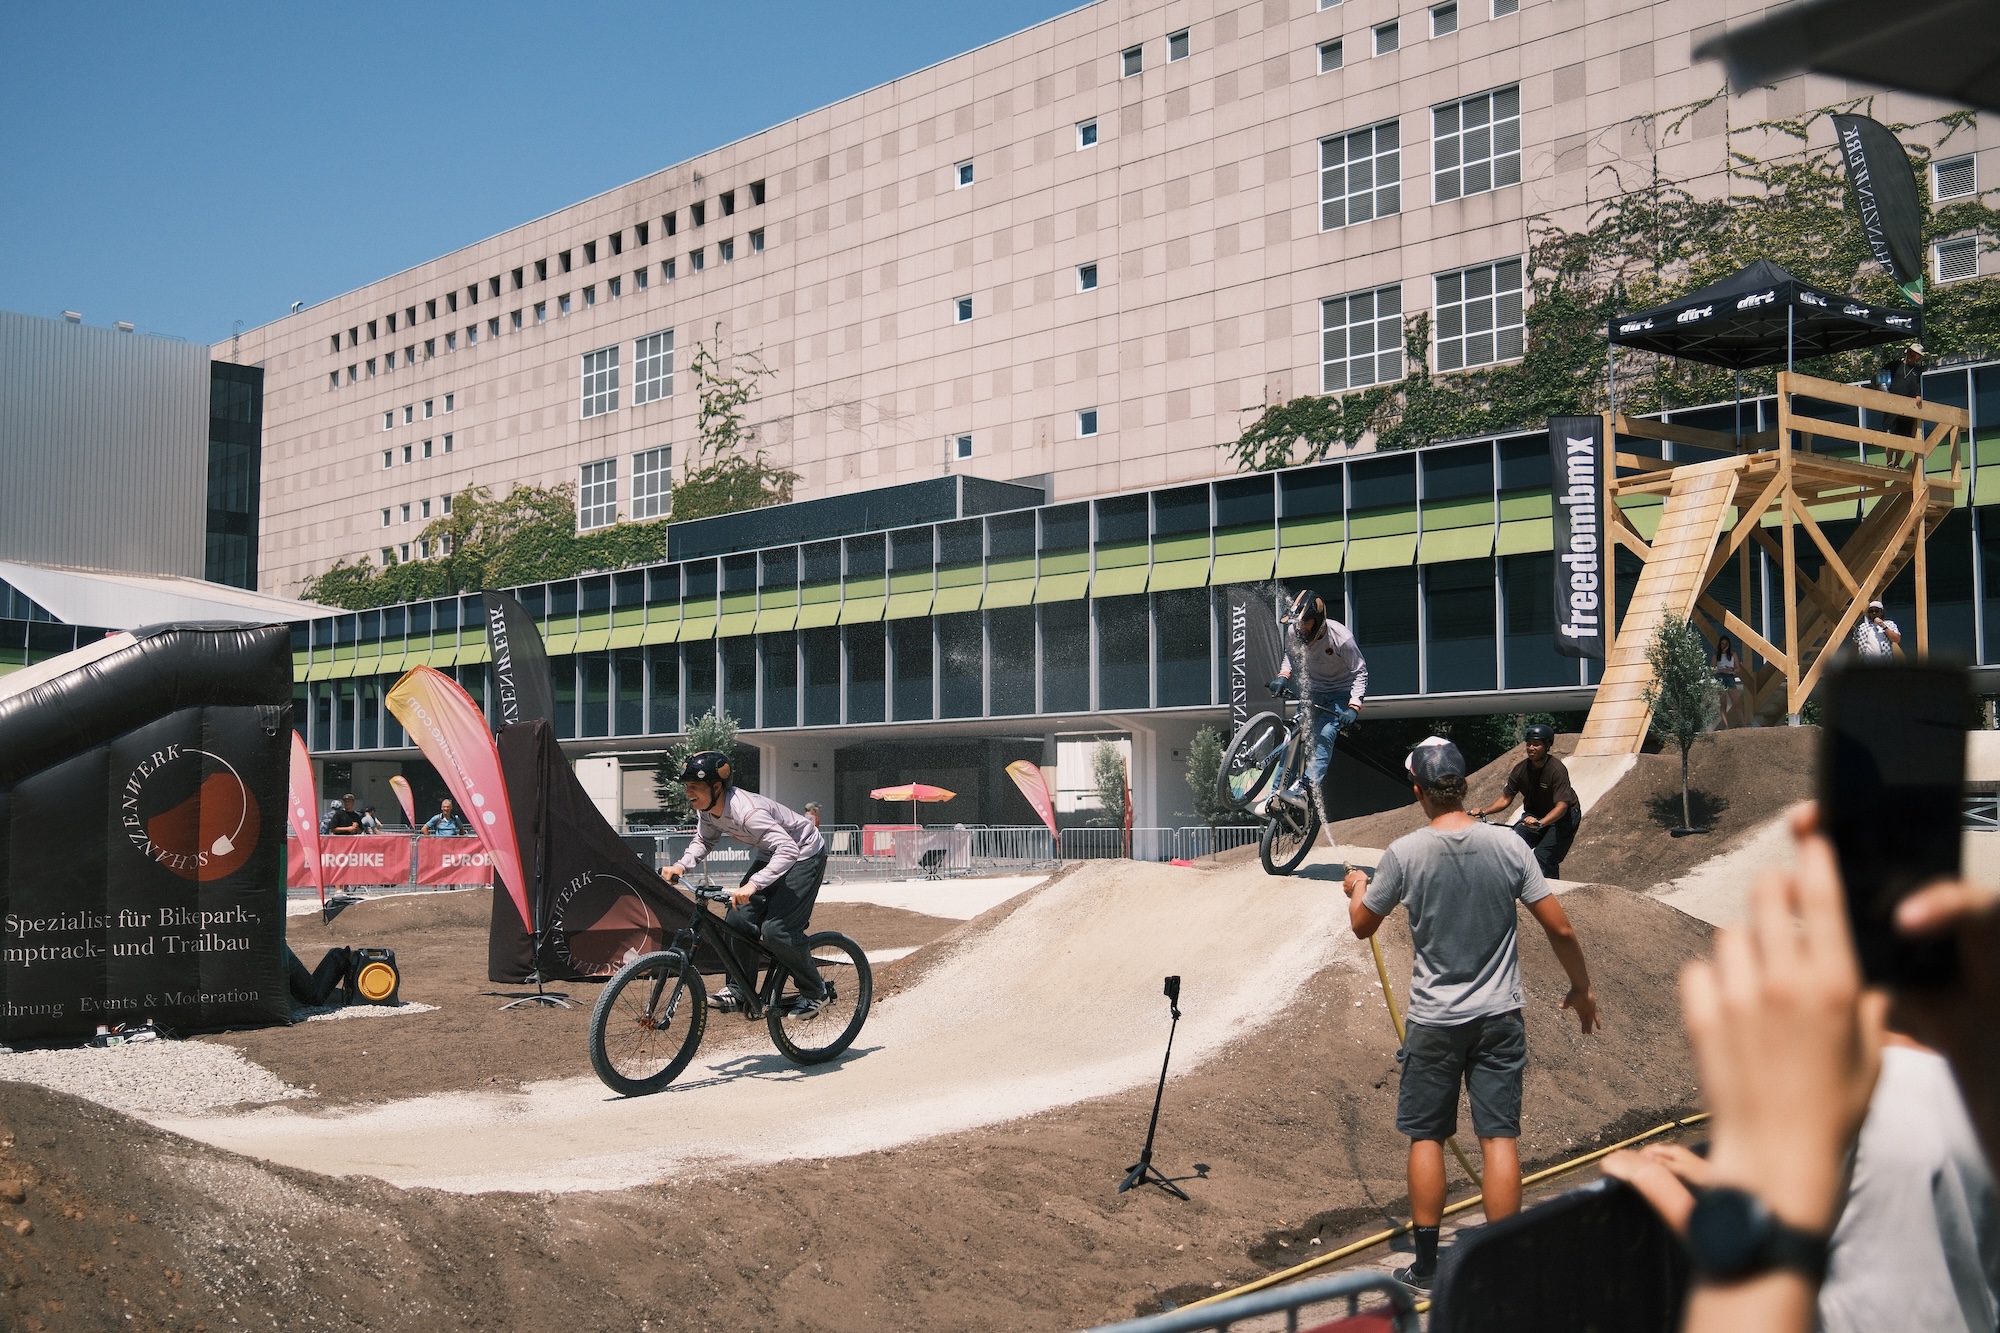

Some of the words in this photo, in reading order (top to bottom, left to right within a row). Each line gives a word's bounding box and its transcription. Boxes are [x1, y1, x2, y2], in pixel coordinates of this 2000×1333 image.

[1736, 290, 1775, 311] dirt
[1677, 304, 1713, 325] dirt
[1560, 436, 1598, 638] freedombmx
[122, 744, 208, 870] SCHANZENWERK
[706, 846, 750, 862] dombmx
[4, 910, 112, 938] Spezialist
[118, 908, 151, 928] für
[158, 904, 262, 930] Bikepark-,
[112, 935, 154, 957] und
[161, 933, 250, 954] Trailbau
[80, 997, 138, 1012] Events
[144, 993, 158, 1007] &
[164, 988, 259, 1007] Moderation
